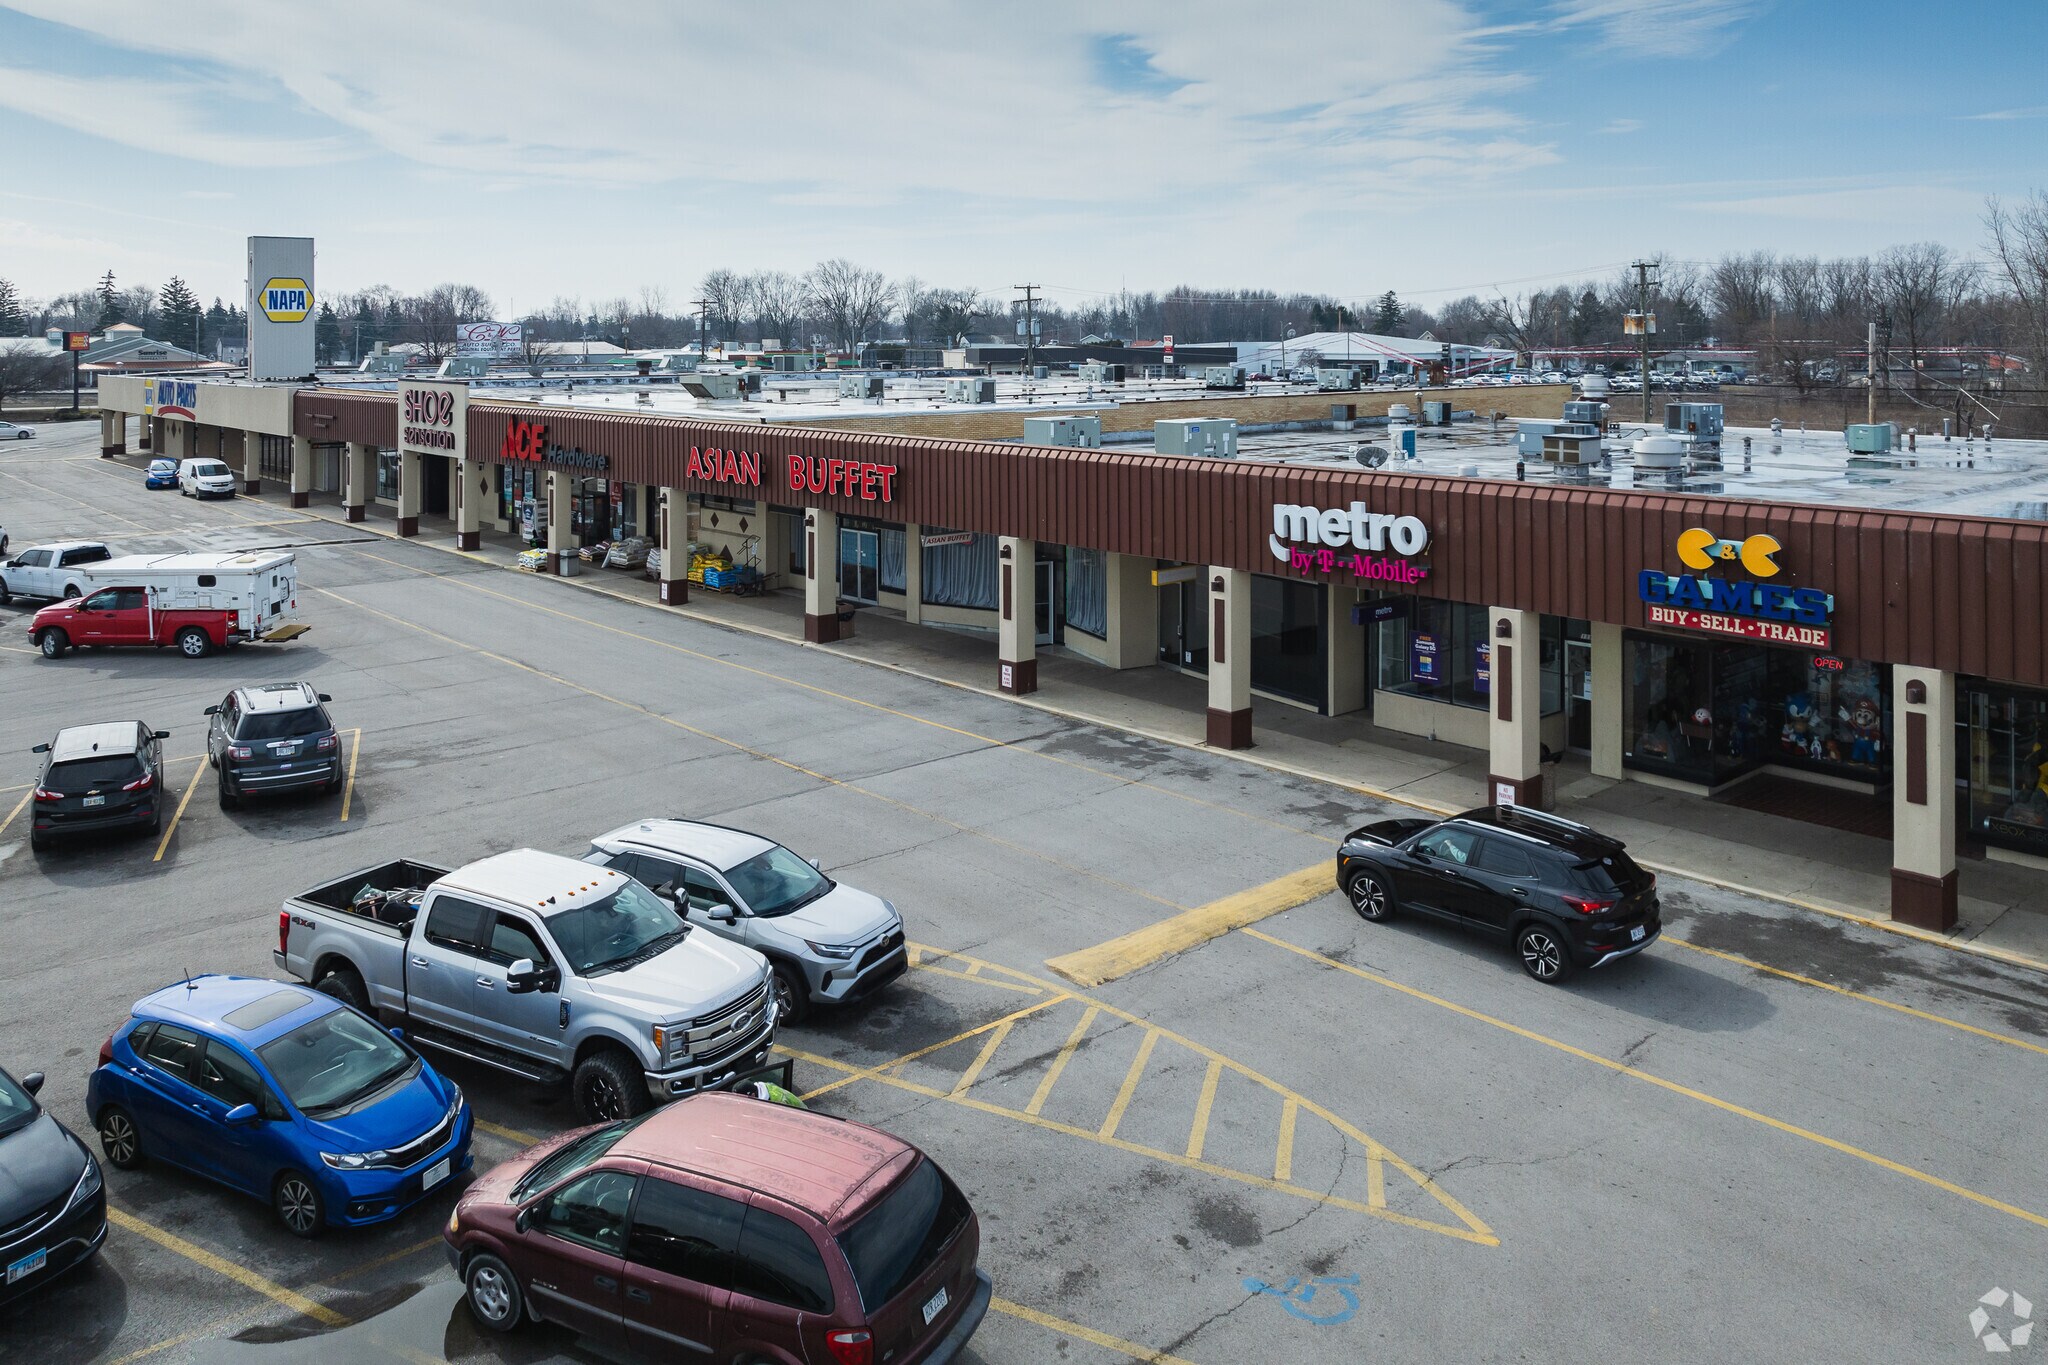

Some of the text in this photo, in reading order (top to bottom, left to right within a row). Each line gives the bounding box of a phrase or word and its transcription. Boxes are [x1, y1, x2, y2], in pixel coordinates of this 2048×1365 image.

[268, 290, 306, 310] NAPA
[158, 380, 197, 409] AUTO PARTS
[500, 415, 608, 471] ACE Hardware
[686, 445, 898, 503] ASIAN BUFFET
[927, 533, 971, 545] ASIAN BUFFET
[1270, 501, 1428, 557] metro
[1290, 546, 1313, 575] by
[1720, 544, 1737, 560] &
[1638, 569, 1830, 625] GAMES
[1375, 606, 1393, 618] metro
[1651, 606, 1825, 646] BUY SELL TRADE
[1415, 639, 1435, 647] Samsung
[1814, 656, 1844, 671] OPEN
[1991, 821, 2027, 838] XBOX
